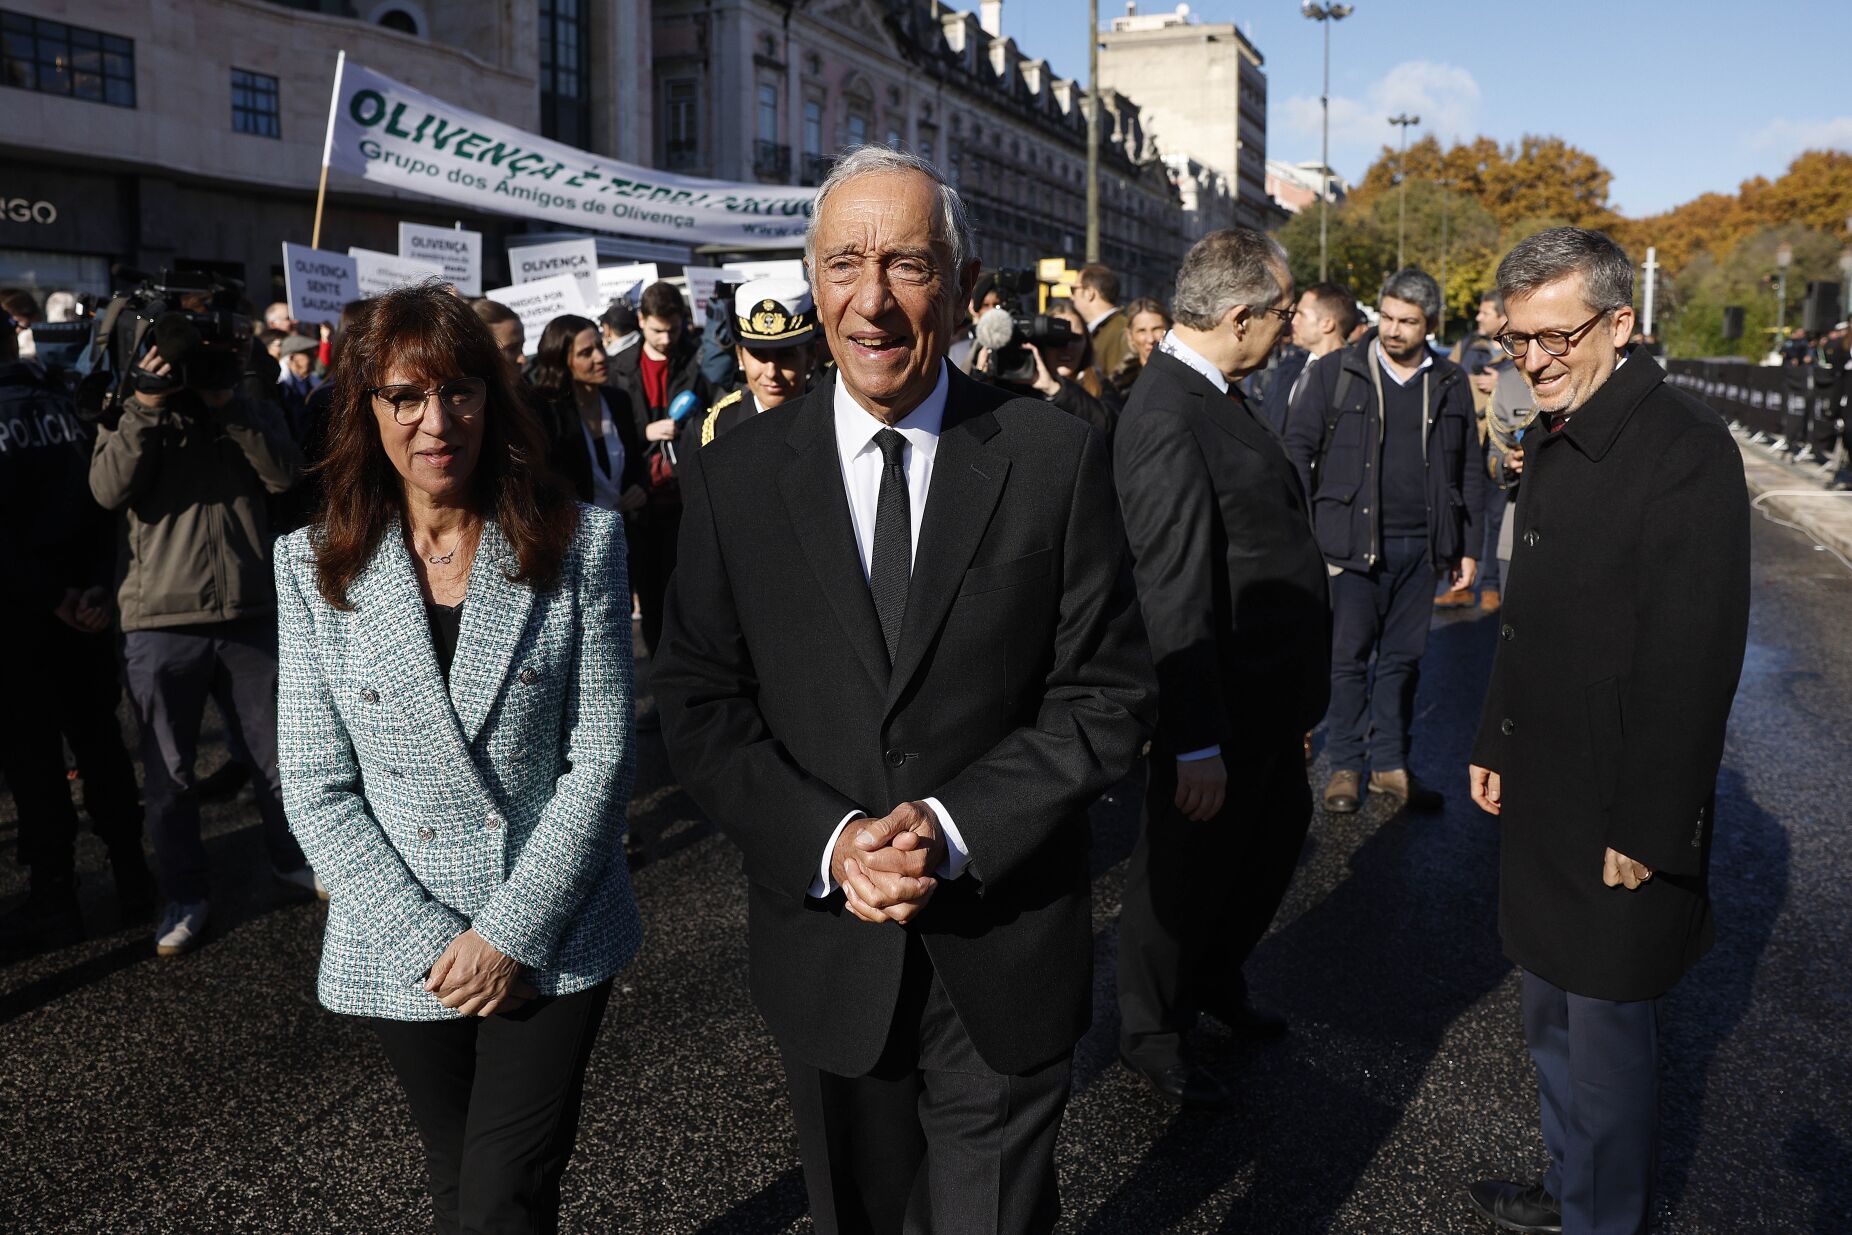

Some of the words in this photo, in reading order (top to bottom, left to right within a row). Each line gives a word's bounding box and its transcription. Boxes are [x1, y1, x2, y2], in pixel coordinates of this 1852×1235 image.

[350, 89, 564, 181] OLIVENÇA
[359, 140, 440, 177] Grupo
[447, 168, 487, 190] dos
[494, 180, 577, 210] Amigos
[582, 198, 606, 215] de
[612, 203, 695, 229] Olivença
[411, 235, 468, 253] OLIVENÇA
[295, 260, 349, 279] OLIVENÇA
[522, 255, 587, 273] OLIVENÇA
[307, 279, 341, 296] SENTE
